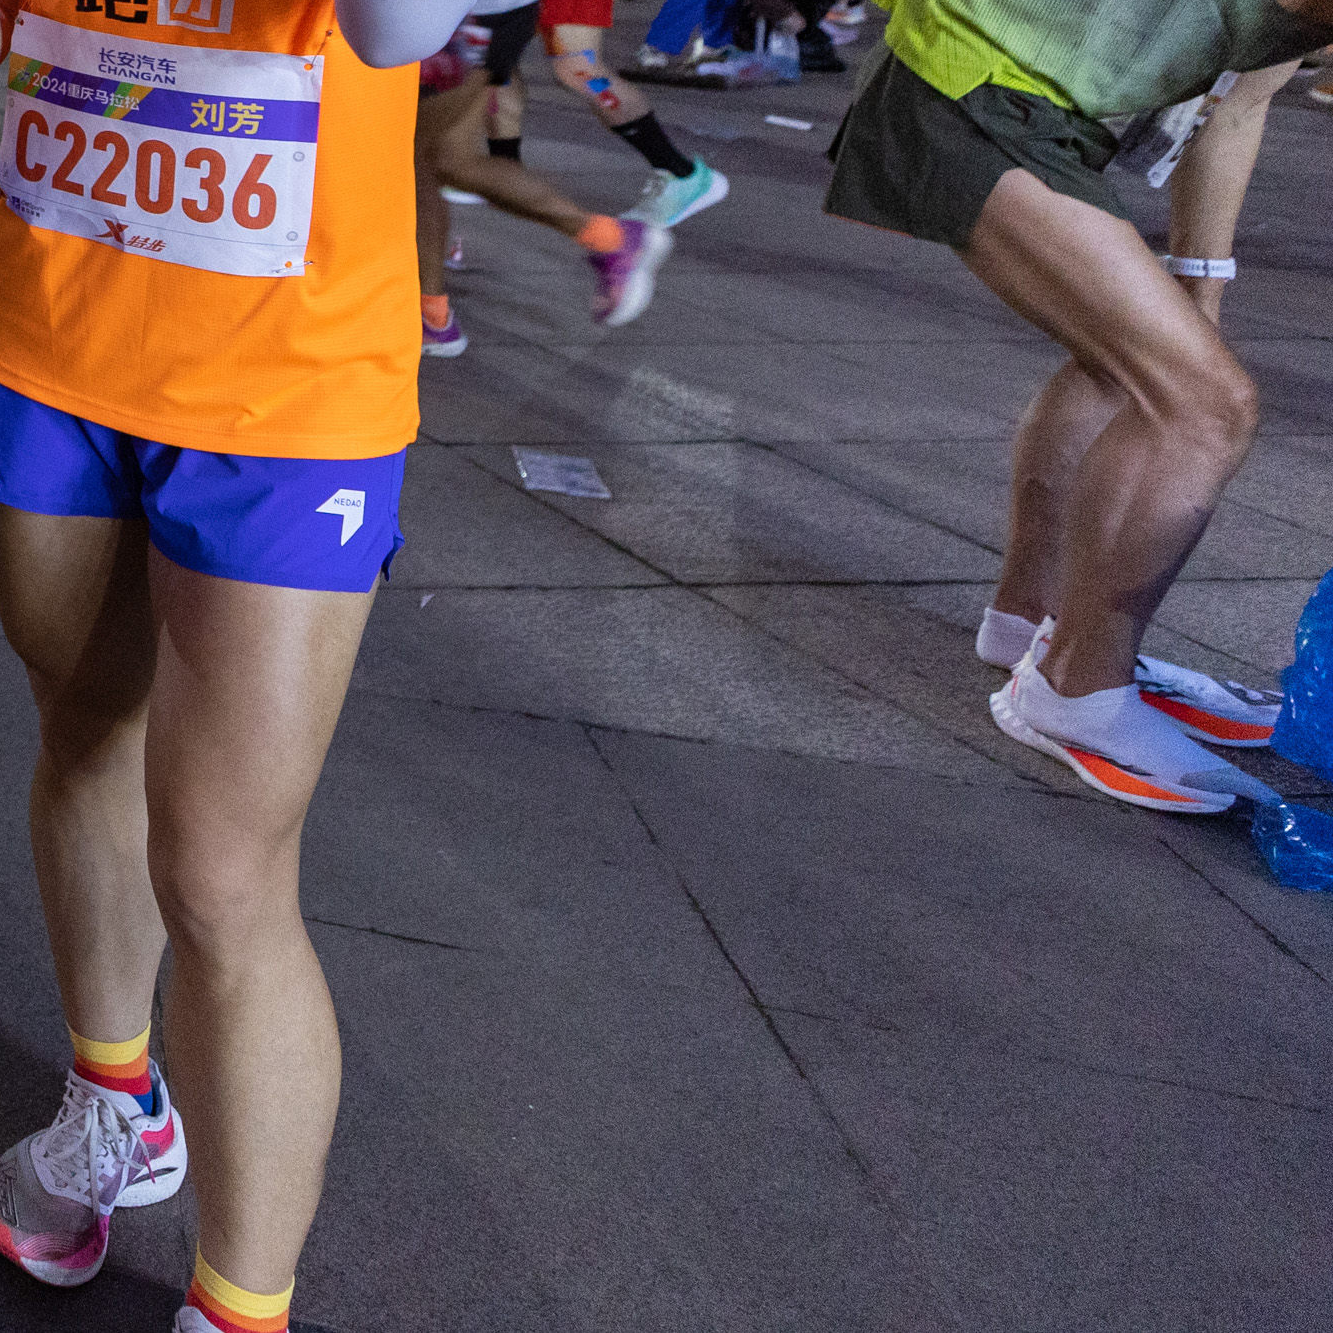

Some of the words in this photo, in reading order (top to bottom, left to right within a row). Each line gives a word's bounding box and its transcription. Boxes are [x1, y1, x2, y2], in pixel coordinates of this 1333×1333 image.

[98, 47, 178, 74] 长安汽车
[98, 63, 177, 86] CHANGAN
[31, 72, 141, 111] 2024重庆马拉松
[190, 98, 265, 135] 刘芳
[15, 109, 278, 231] C22036
[334, 497, 362, 508] NEDAO
